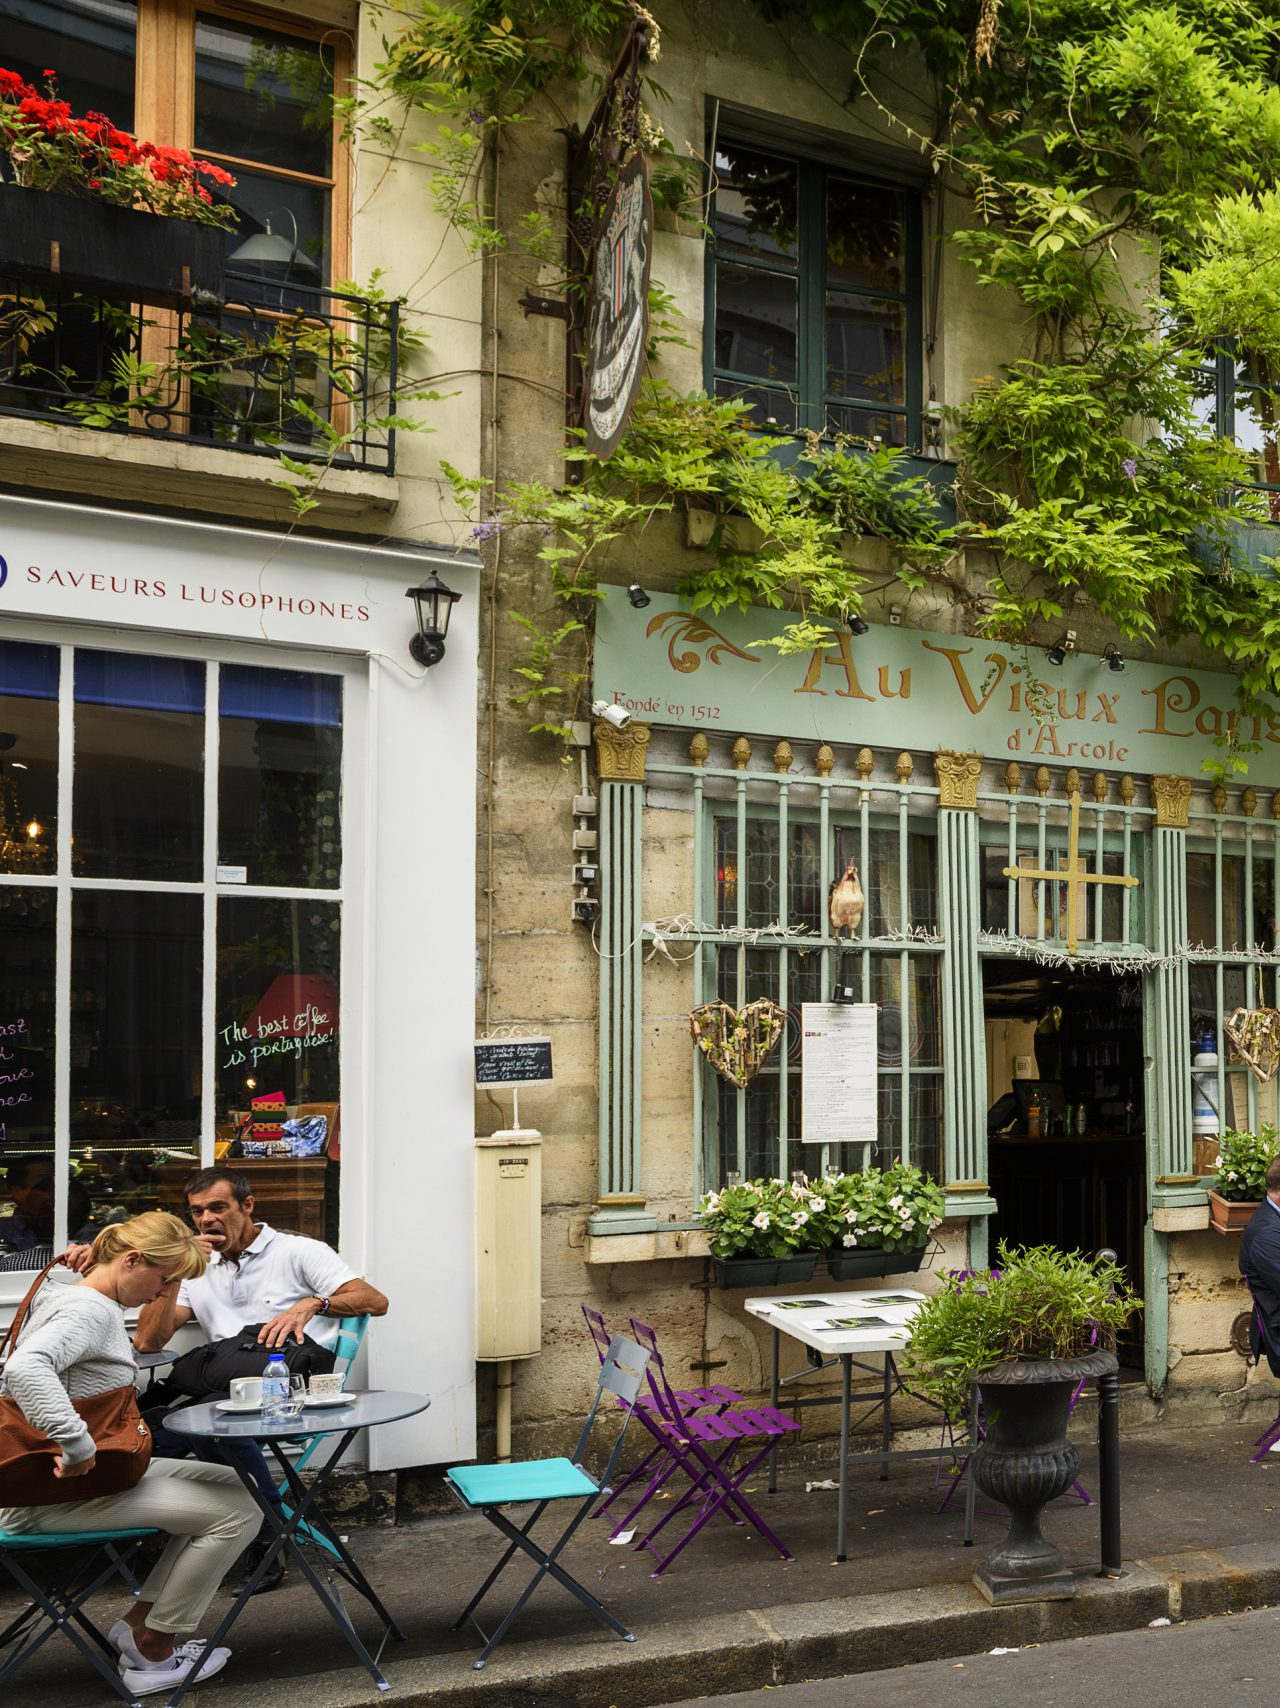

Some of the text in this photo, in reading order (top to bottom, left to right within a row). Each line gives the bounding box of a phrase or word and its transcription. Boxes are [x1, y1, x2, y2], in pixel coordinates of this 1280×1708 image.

[27, 566, 167, 598] SAVEURS
[181, 583, 370, 622] LUSOPHONES
[793, 631, 912, 703] Au
[921, 640, 1121, 724] Vieux
[668, 704, 685, 721] en
[690, 705, 720, 721] 1512
[1007, 724, 1130, 763] d'Arcole
[218, 1020, 253, 1046] The
[257, 1015, 289, 1039] best
[223, 1049, 246, 1069] is
